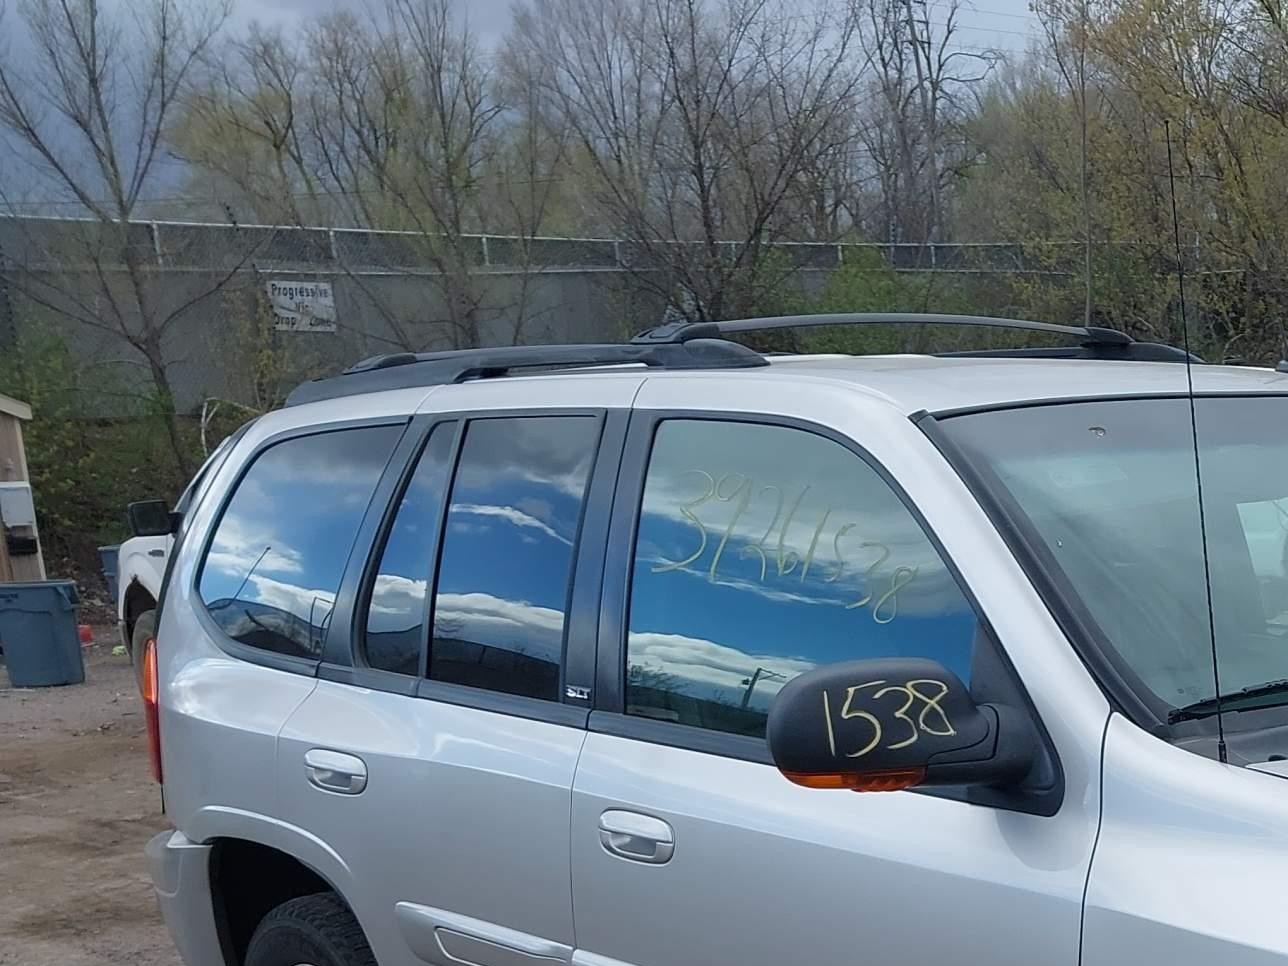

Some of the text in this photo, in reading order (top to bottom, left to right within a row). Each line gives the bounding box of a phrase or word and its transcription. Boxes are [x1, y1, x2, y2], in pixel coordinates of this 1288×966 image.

[271, 283, 329, 300] Progressive
[652, 469, 918, 624] 39261538
[823, 679, 956, 757] 1538
